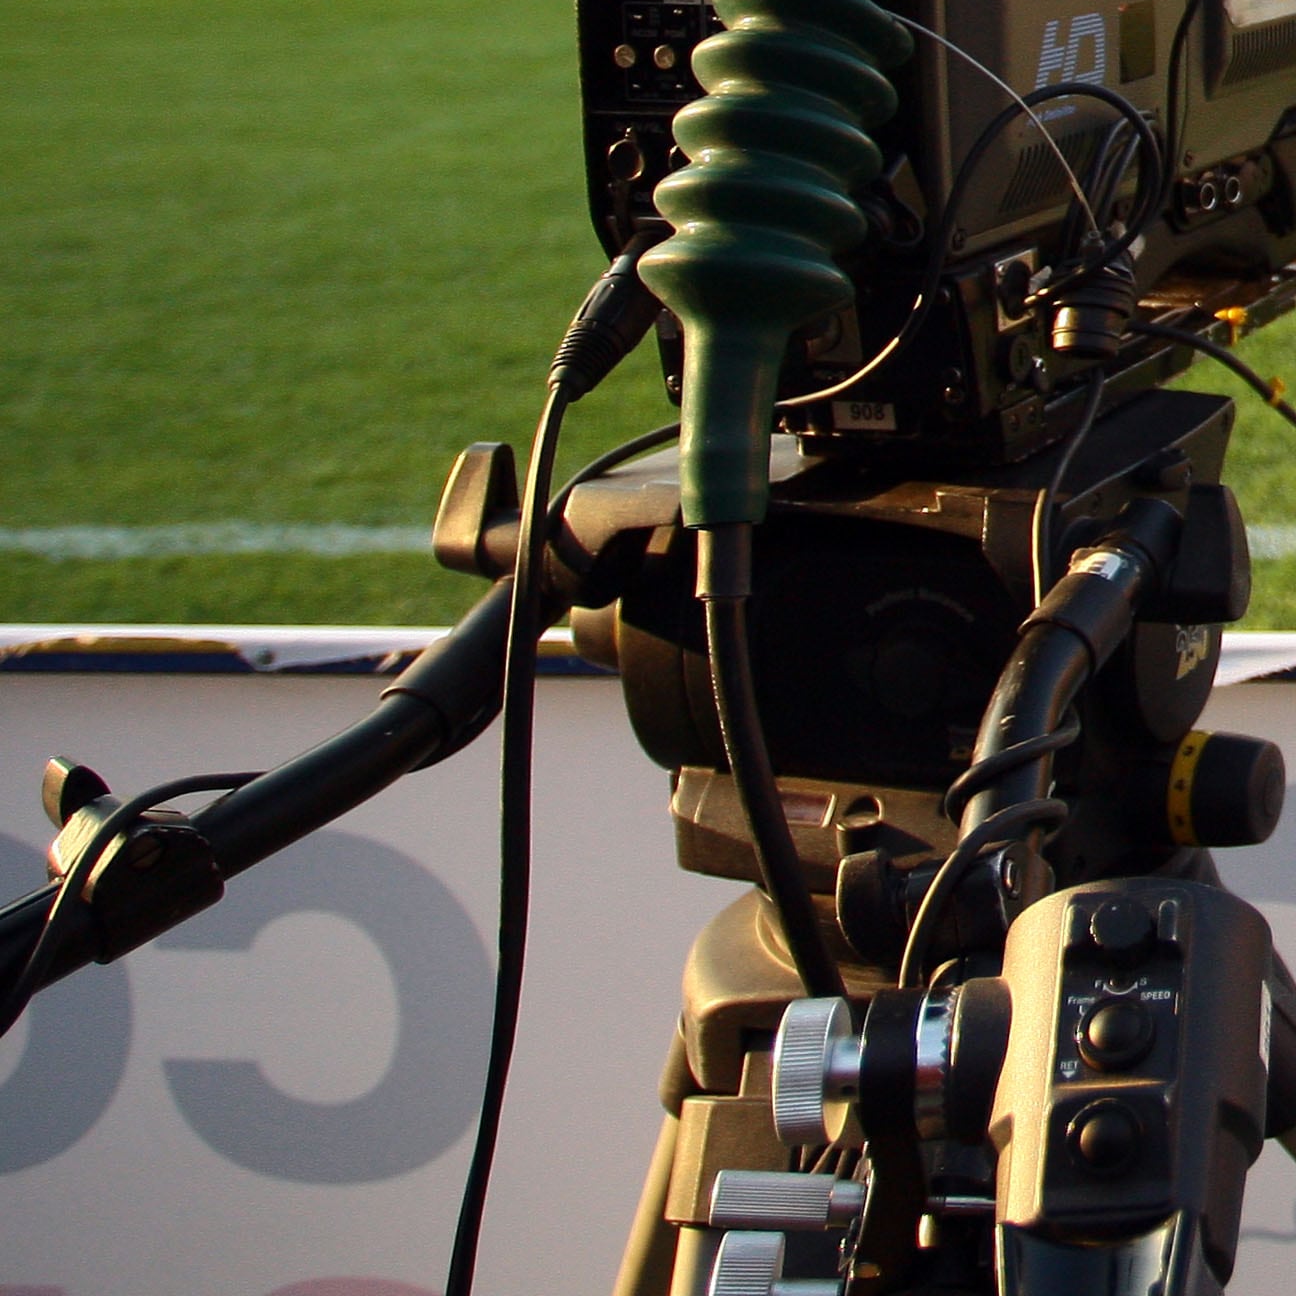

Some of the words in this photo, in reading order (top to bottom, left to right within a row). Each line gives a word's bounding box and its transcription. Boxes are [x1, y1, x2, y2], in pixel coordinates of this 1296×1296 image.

[1034, 12, 1106, 101] HD
[1140, 990, 1171, 1001] SPEED
[1060, 1059, 1079, 1071] RET
